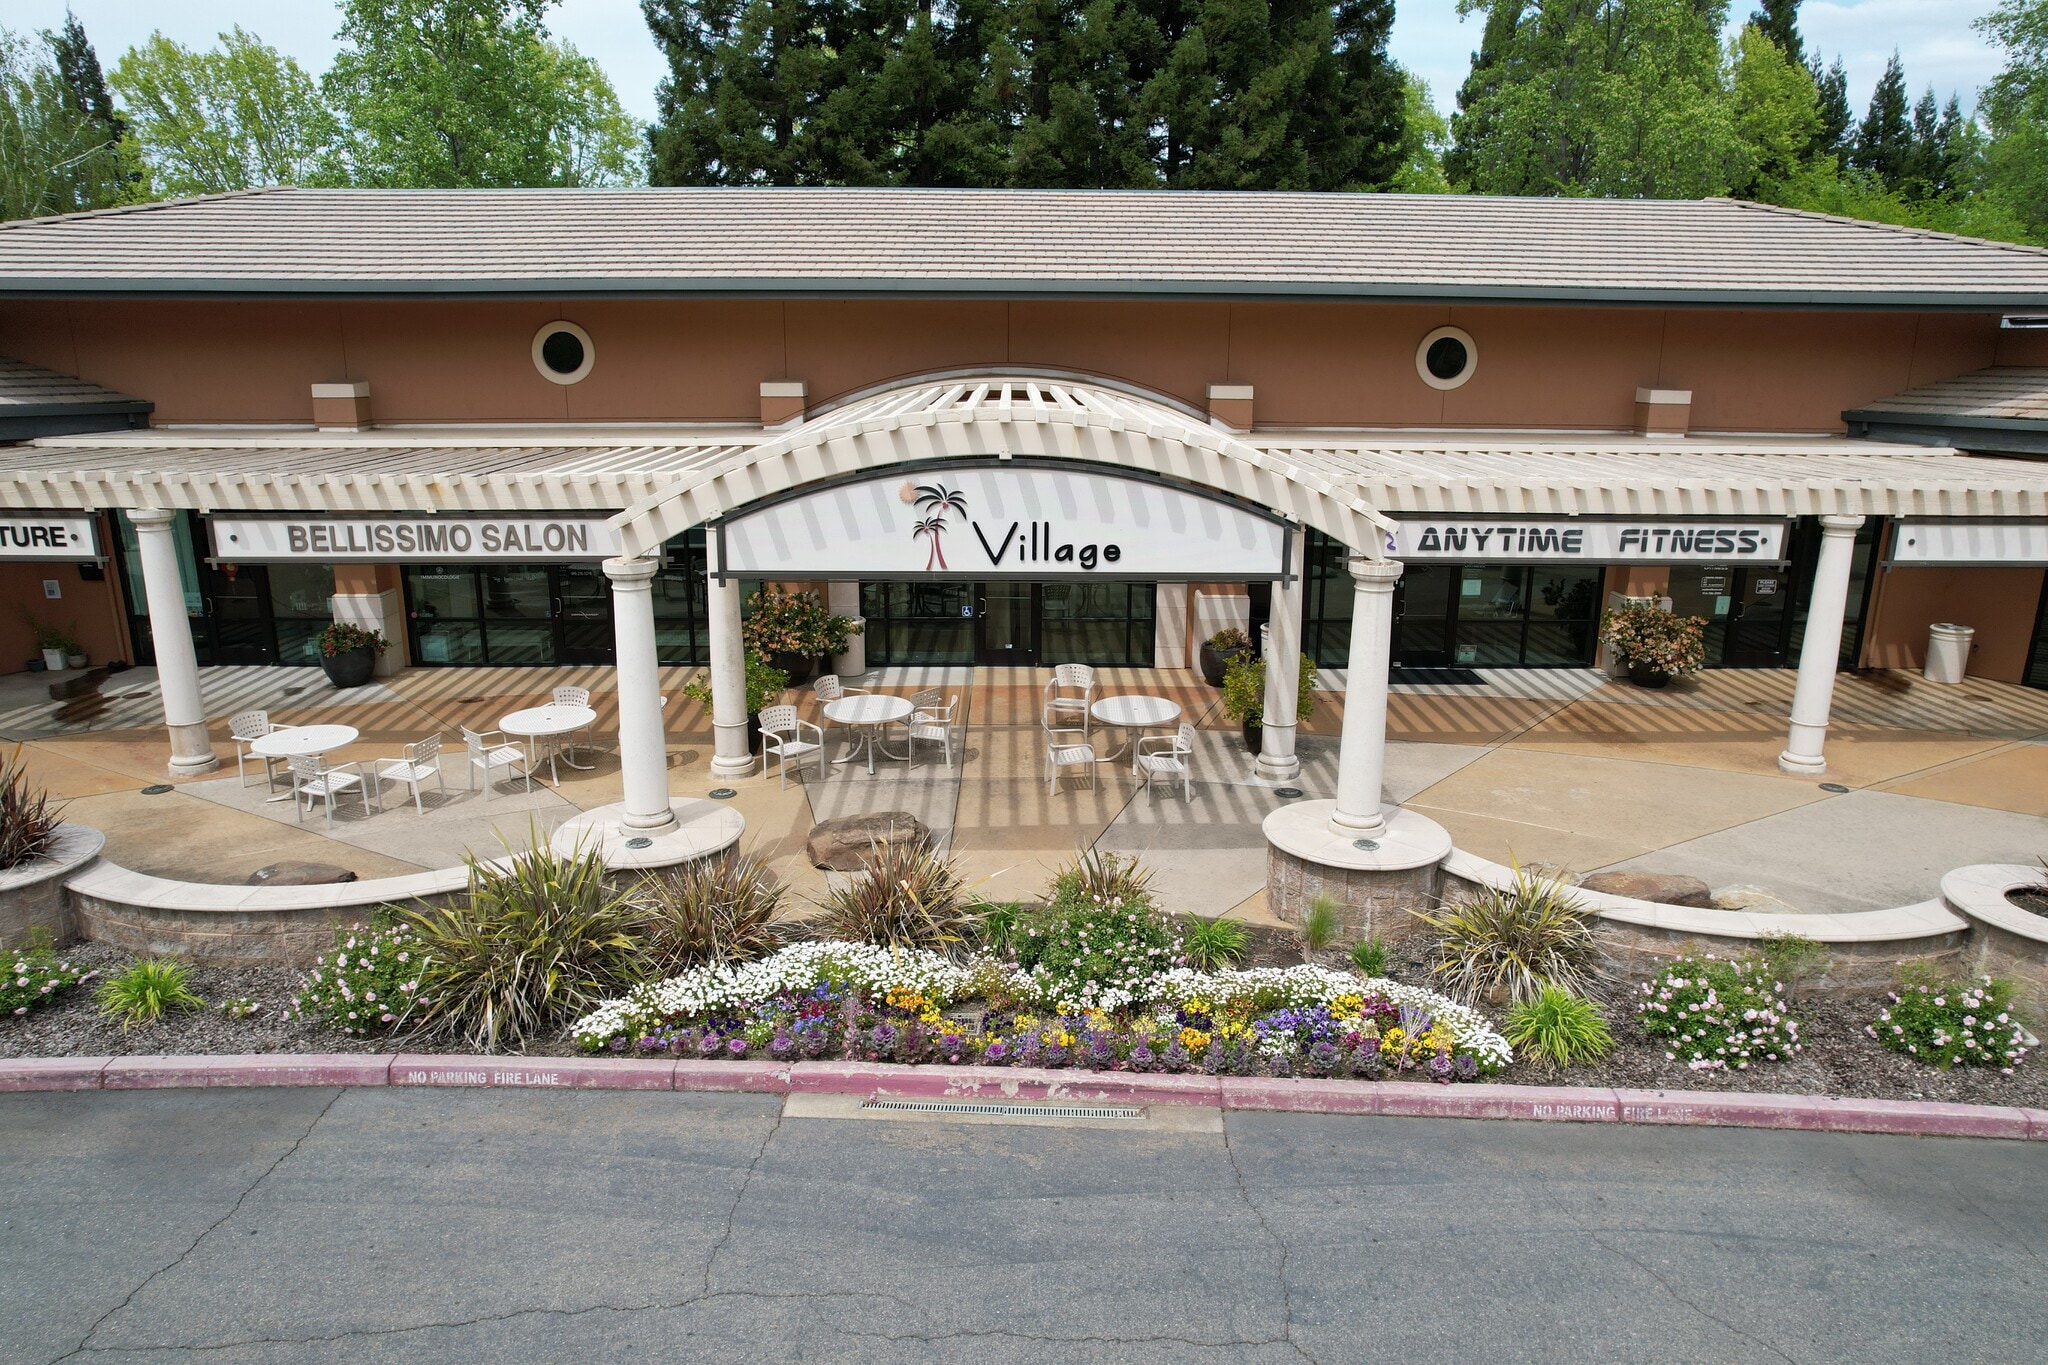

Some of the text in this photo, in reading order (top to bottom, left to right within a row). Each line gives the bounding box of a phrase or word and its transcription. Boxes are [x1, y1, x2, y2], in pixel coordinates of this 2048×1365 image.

[287, 524, 588, 552] BELLISSIMO SALON
[972, 521, 1121, 569] Village
[1418, 526, 1760, 553] ANYTIME FITNESS
[408, 1071, 559, 1085] NO PARKING FIRE LANE
[1533, 1104, 1552, 1117] NO
[1556, 1105, 1616, 1119] PARKING
[1623, 1106, 1653, 1120] FIRE
